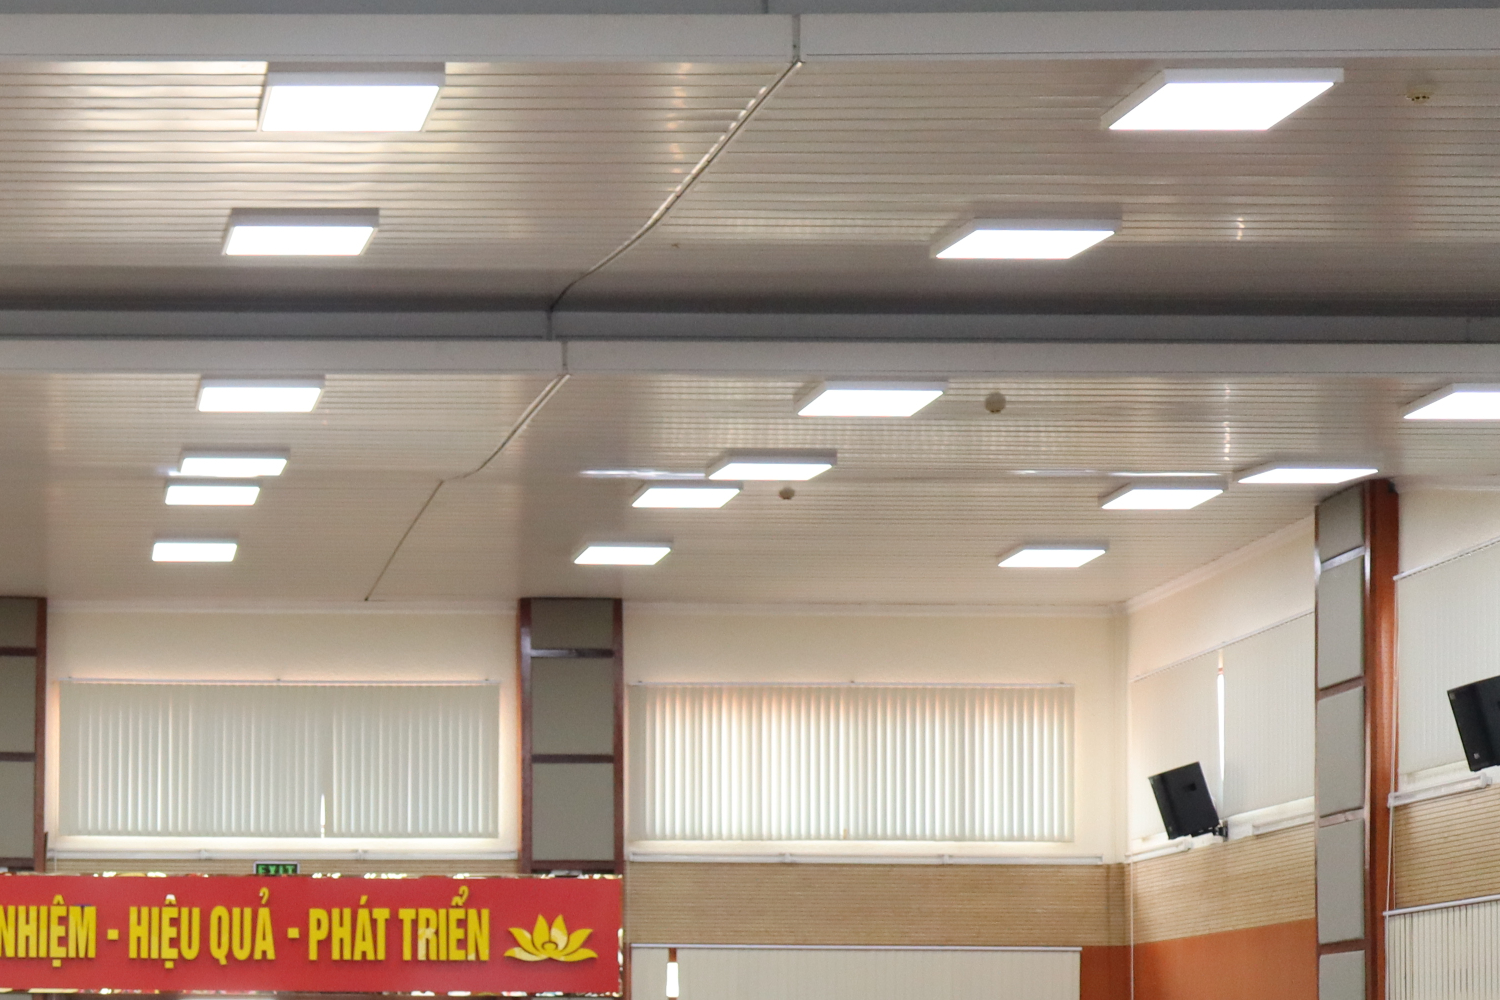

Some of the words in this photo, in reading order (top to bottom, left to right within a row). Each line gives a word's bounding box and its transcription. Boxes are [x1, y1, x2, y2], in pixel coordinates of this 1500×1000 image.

[128, 893, 201, 969] HIỆU
[209, 887, 276, 965] QUẢ
[308, 896, 390, 962] PHÁT
[399, 885, 490, 962] TRIỂN
